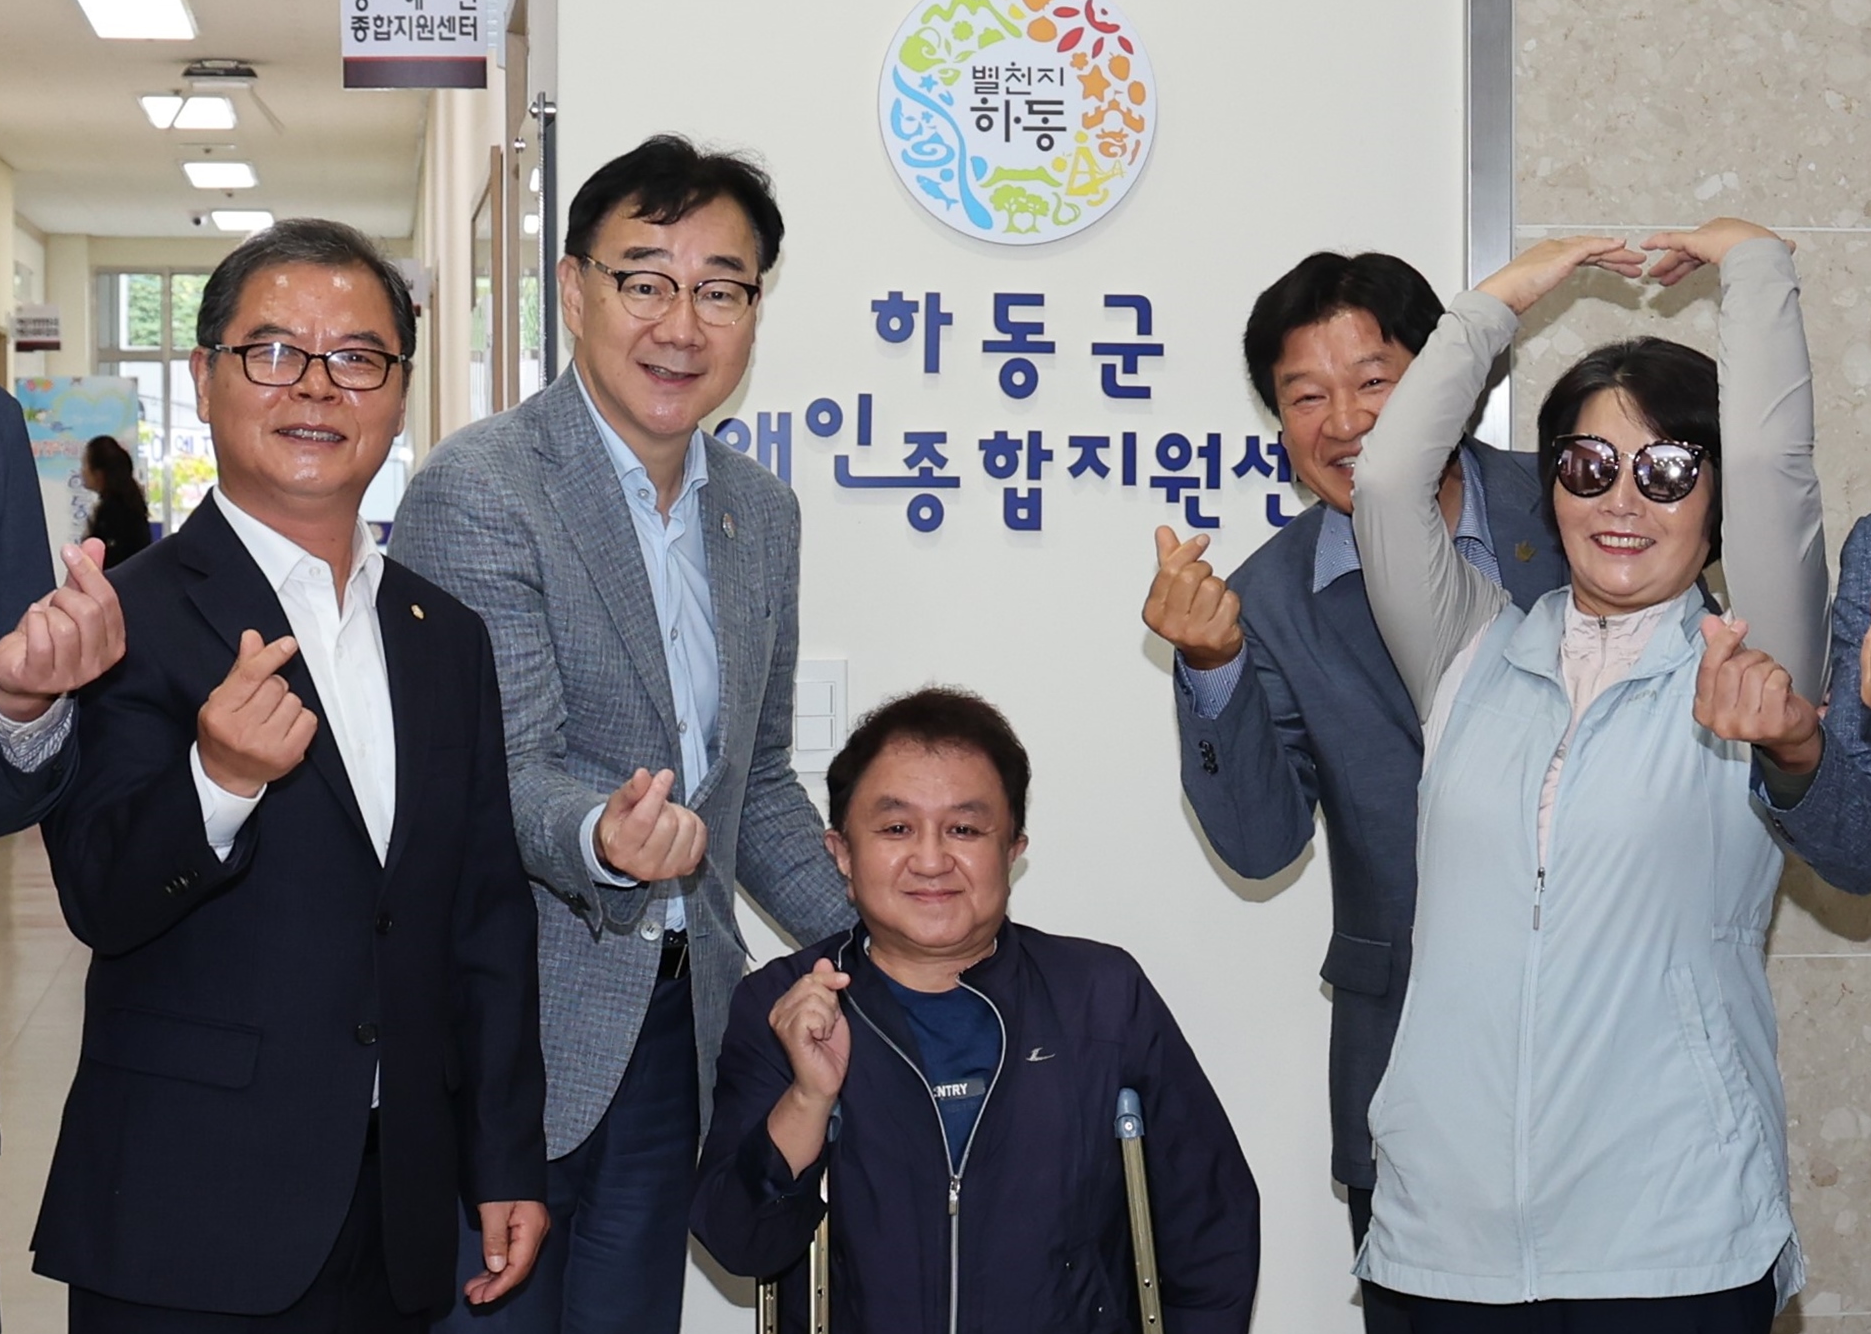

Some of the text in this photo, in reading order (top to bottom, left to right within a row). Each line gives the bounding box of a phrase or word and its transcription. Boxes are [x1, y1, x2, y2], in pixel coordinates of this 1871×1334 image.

[350, 14, 478, 42] 종합지원센터
[972, 61, 1064, 95] 별천지
[969, 97, 1067, 152] 하동
[871, 291, 1164, 399] 하동군
